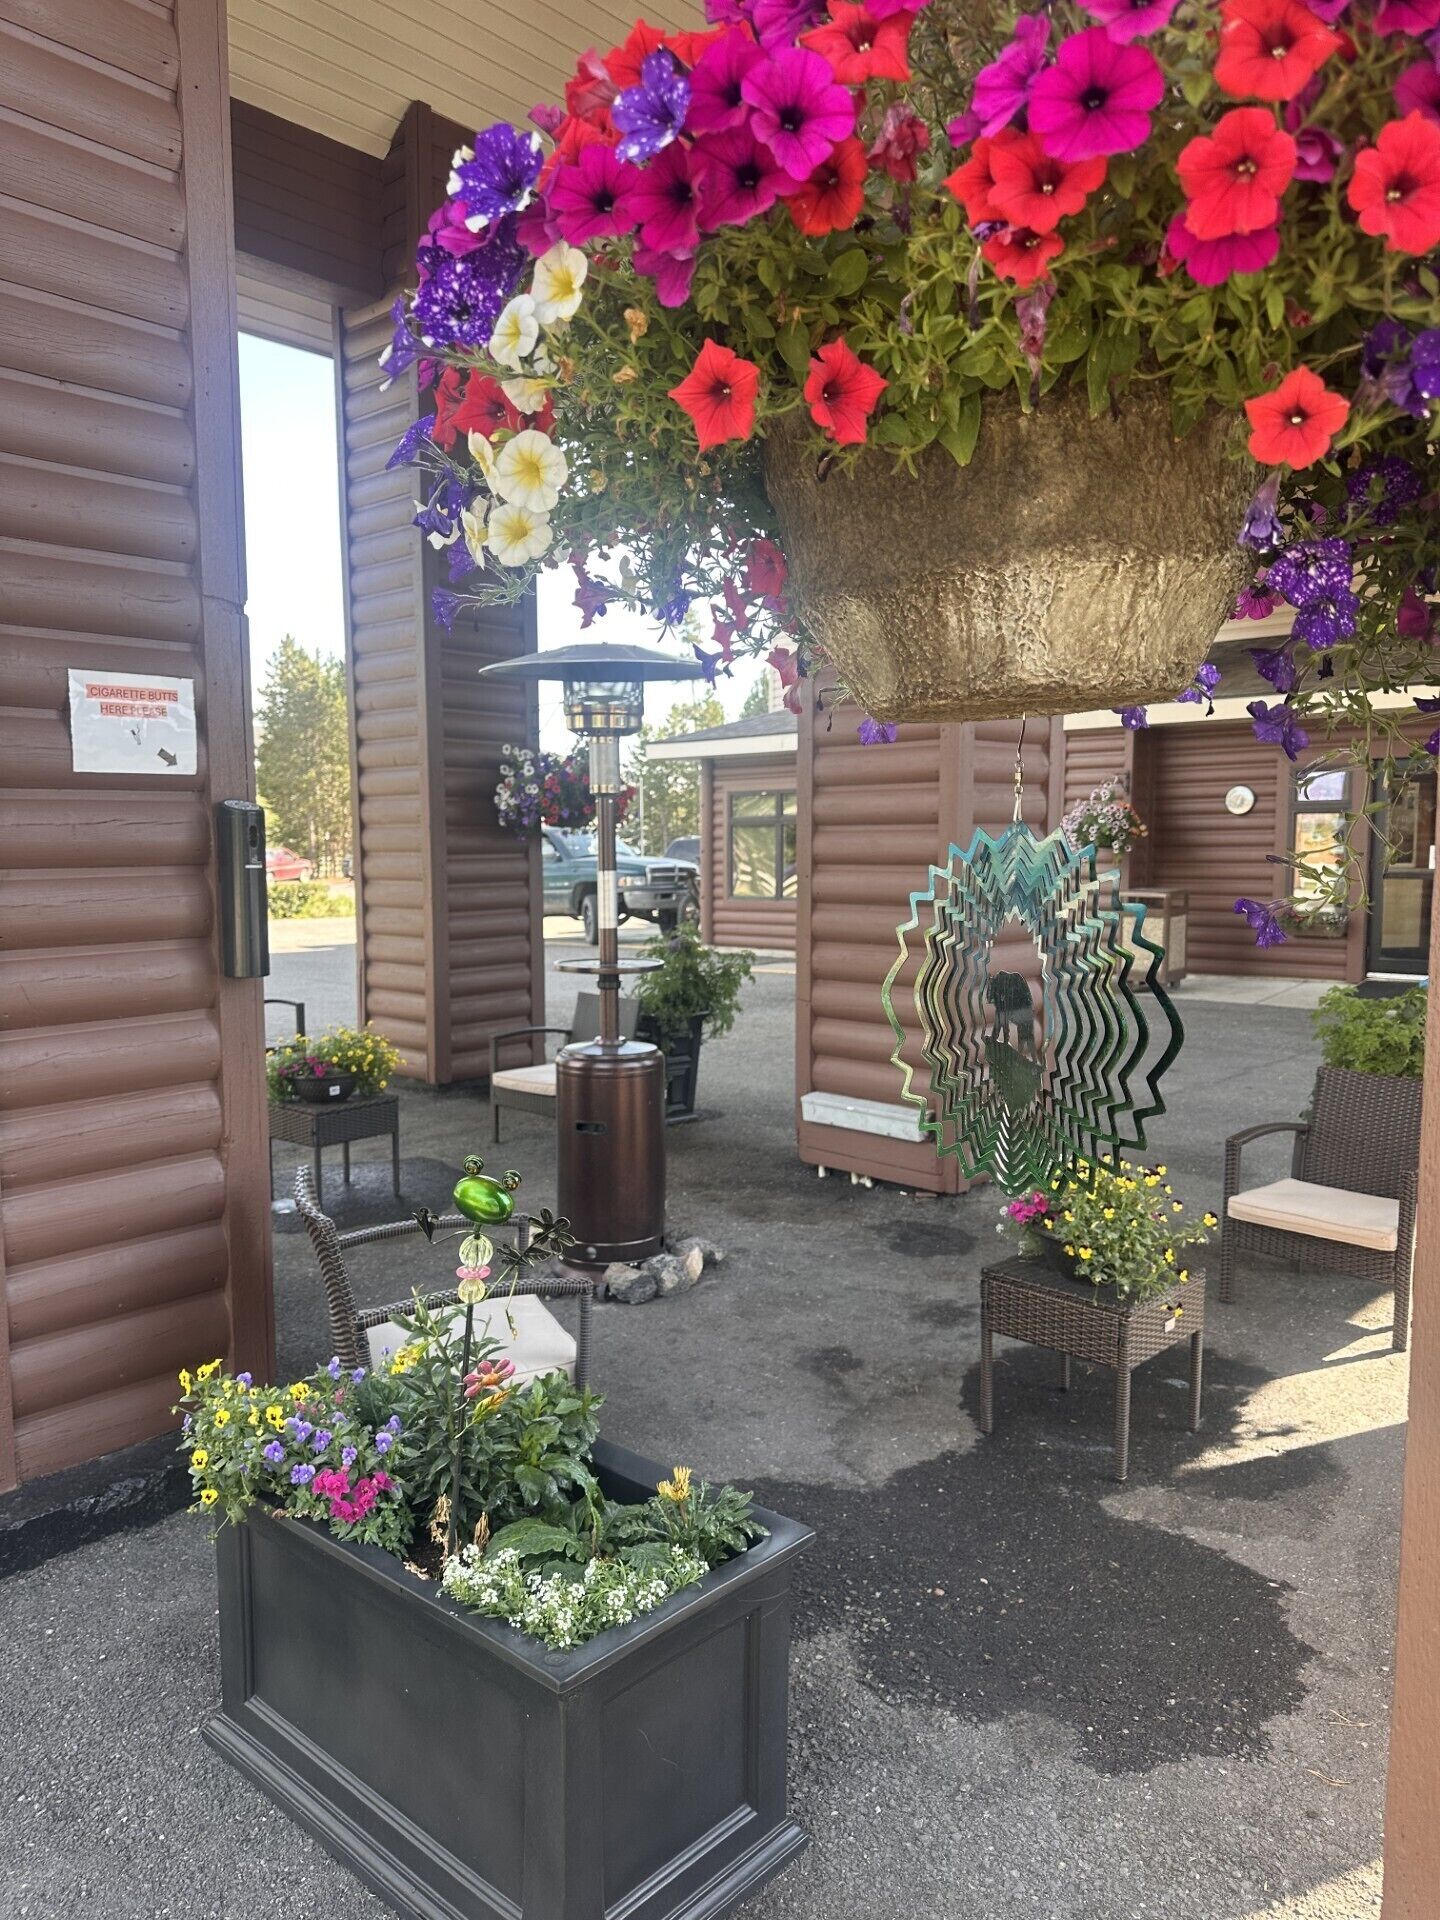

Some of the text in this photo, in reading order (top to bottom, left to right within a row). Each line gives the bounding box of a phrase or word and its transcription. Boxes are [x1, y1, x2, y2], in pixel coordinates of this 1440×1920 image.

[90, 686, 178, 702] CIGARETTE BUTTS
[100, 704, 128, 715] HERE
